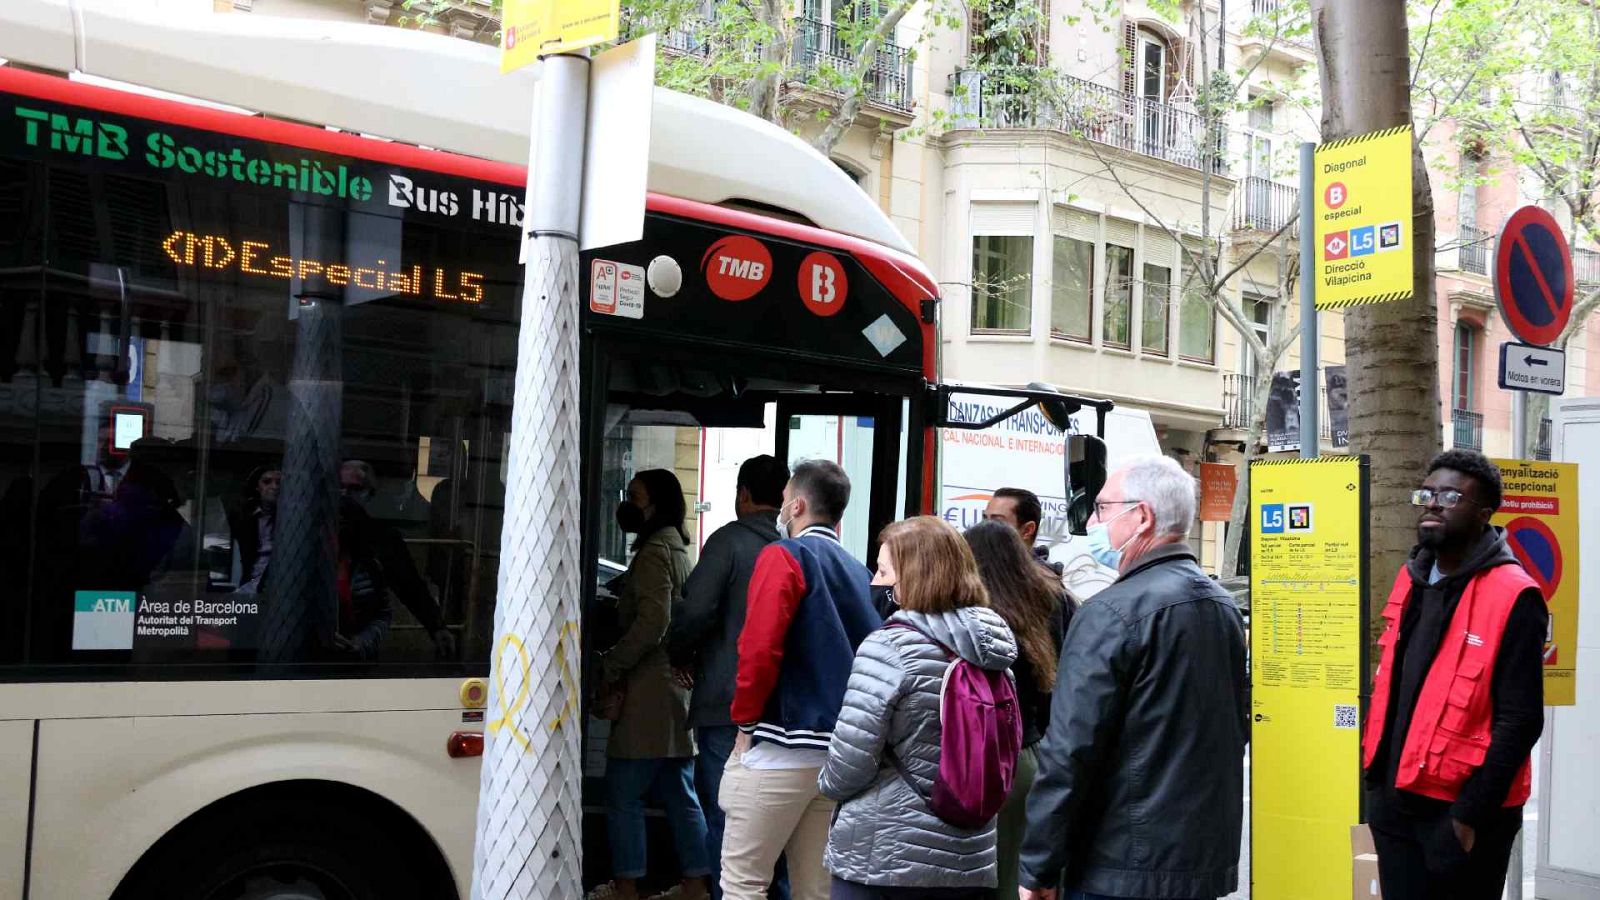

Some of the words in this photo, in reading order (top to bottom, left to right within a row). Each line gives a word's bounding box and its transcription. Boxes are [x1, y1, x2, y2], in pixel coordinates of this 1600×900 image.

[15, 106, 129, 160] TMB
[145, 131, 373, 202] Sostenible
[388, 174, 460, 216] Bus
[472, 188, 525, 228] Híb
[1324, 156, 1367, 174] Diagonal
[1330, 187, 1343, 205] B
[1324, 205, 1362, 221] especial
[1352, 232, 1373, 251] L5
[718, 255, 765, 281] TMB
[1325, 261, 1365, 275] Direcció
[434, 268, 484, 303] L5
[812, 264, 836, 304] B
[1325, 272, 1372, 287] Vilapicina
[1507, 370, 1529, 383] Motos
[950, 401, 994, 422] DANZAS
[943, 429, 960, 443] CAL
[962, 431, 1003, 449] NACIONAL
[1016, 439, 1066, 456] INTERNACIO
[1499, 467, 1559, 479] enyalització
[1503, 482, 1556, 493] xcepcional
[1262, 510, 1283, 528] L5
[92, 598, 130, 613] ATM
[138, 596, 170, 613] Àrea
[174, 600, 191, 613] de
[194, 600, 258, 614] Barcelona
[137, 615, 178, 625] Autoritat
[179, 615, 194, 625] del
[195, 615, 237, 626] Transport
[137, 626, 189, 638] Metropolità
